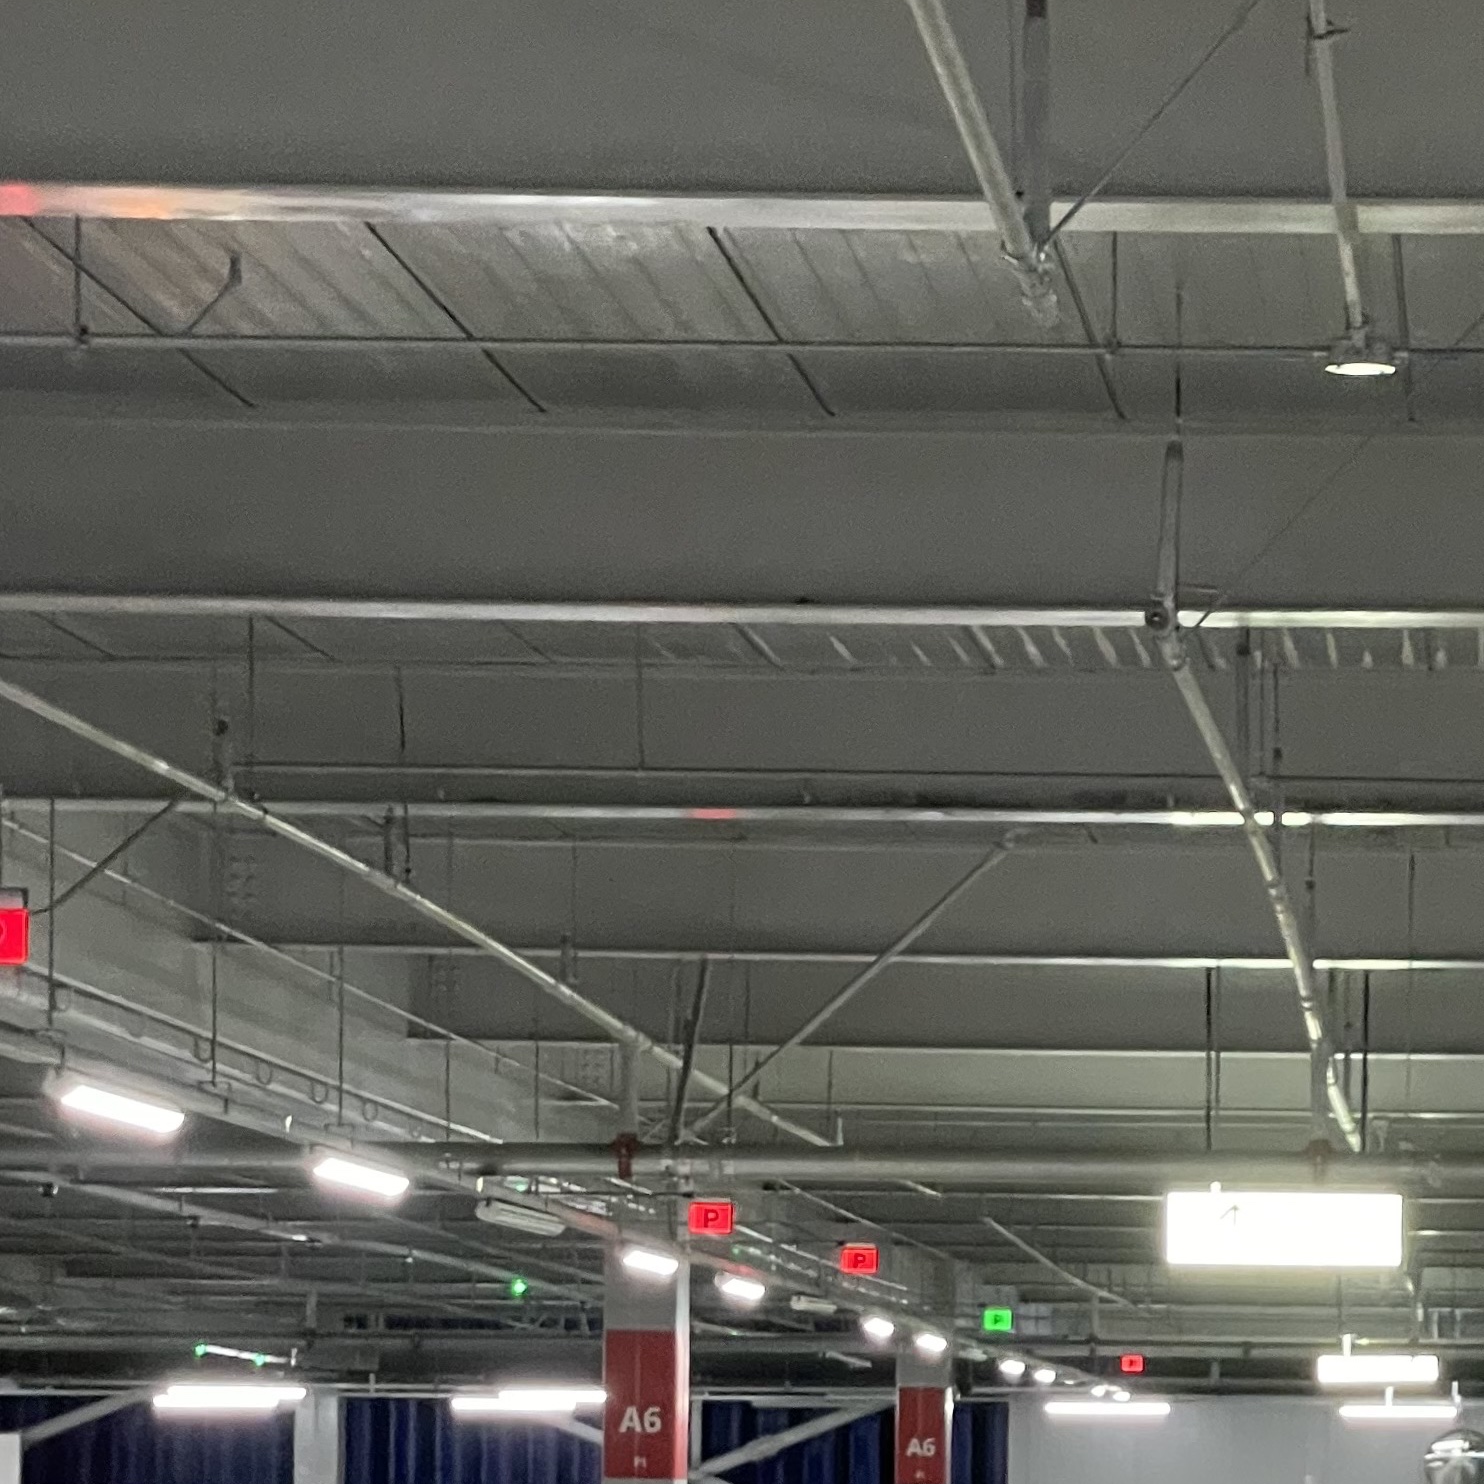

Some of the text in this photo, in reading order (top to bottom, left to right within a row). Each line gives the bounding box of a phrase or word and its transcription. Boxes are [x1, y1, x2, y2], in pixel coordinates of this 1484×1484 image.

[703, 1208, 719, 1228] P
[852, 1253, 866, 1268] P
[618, 1406, 662, 1433] A6
[906, 1438, 935, 1457] A6
